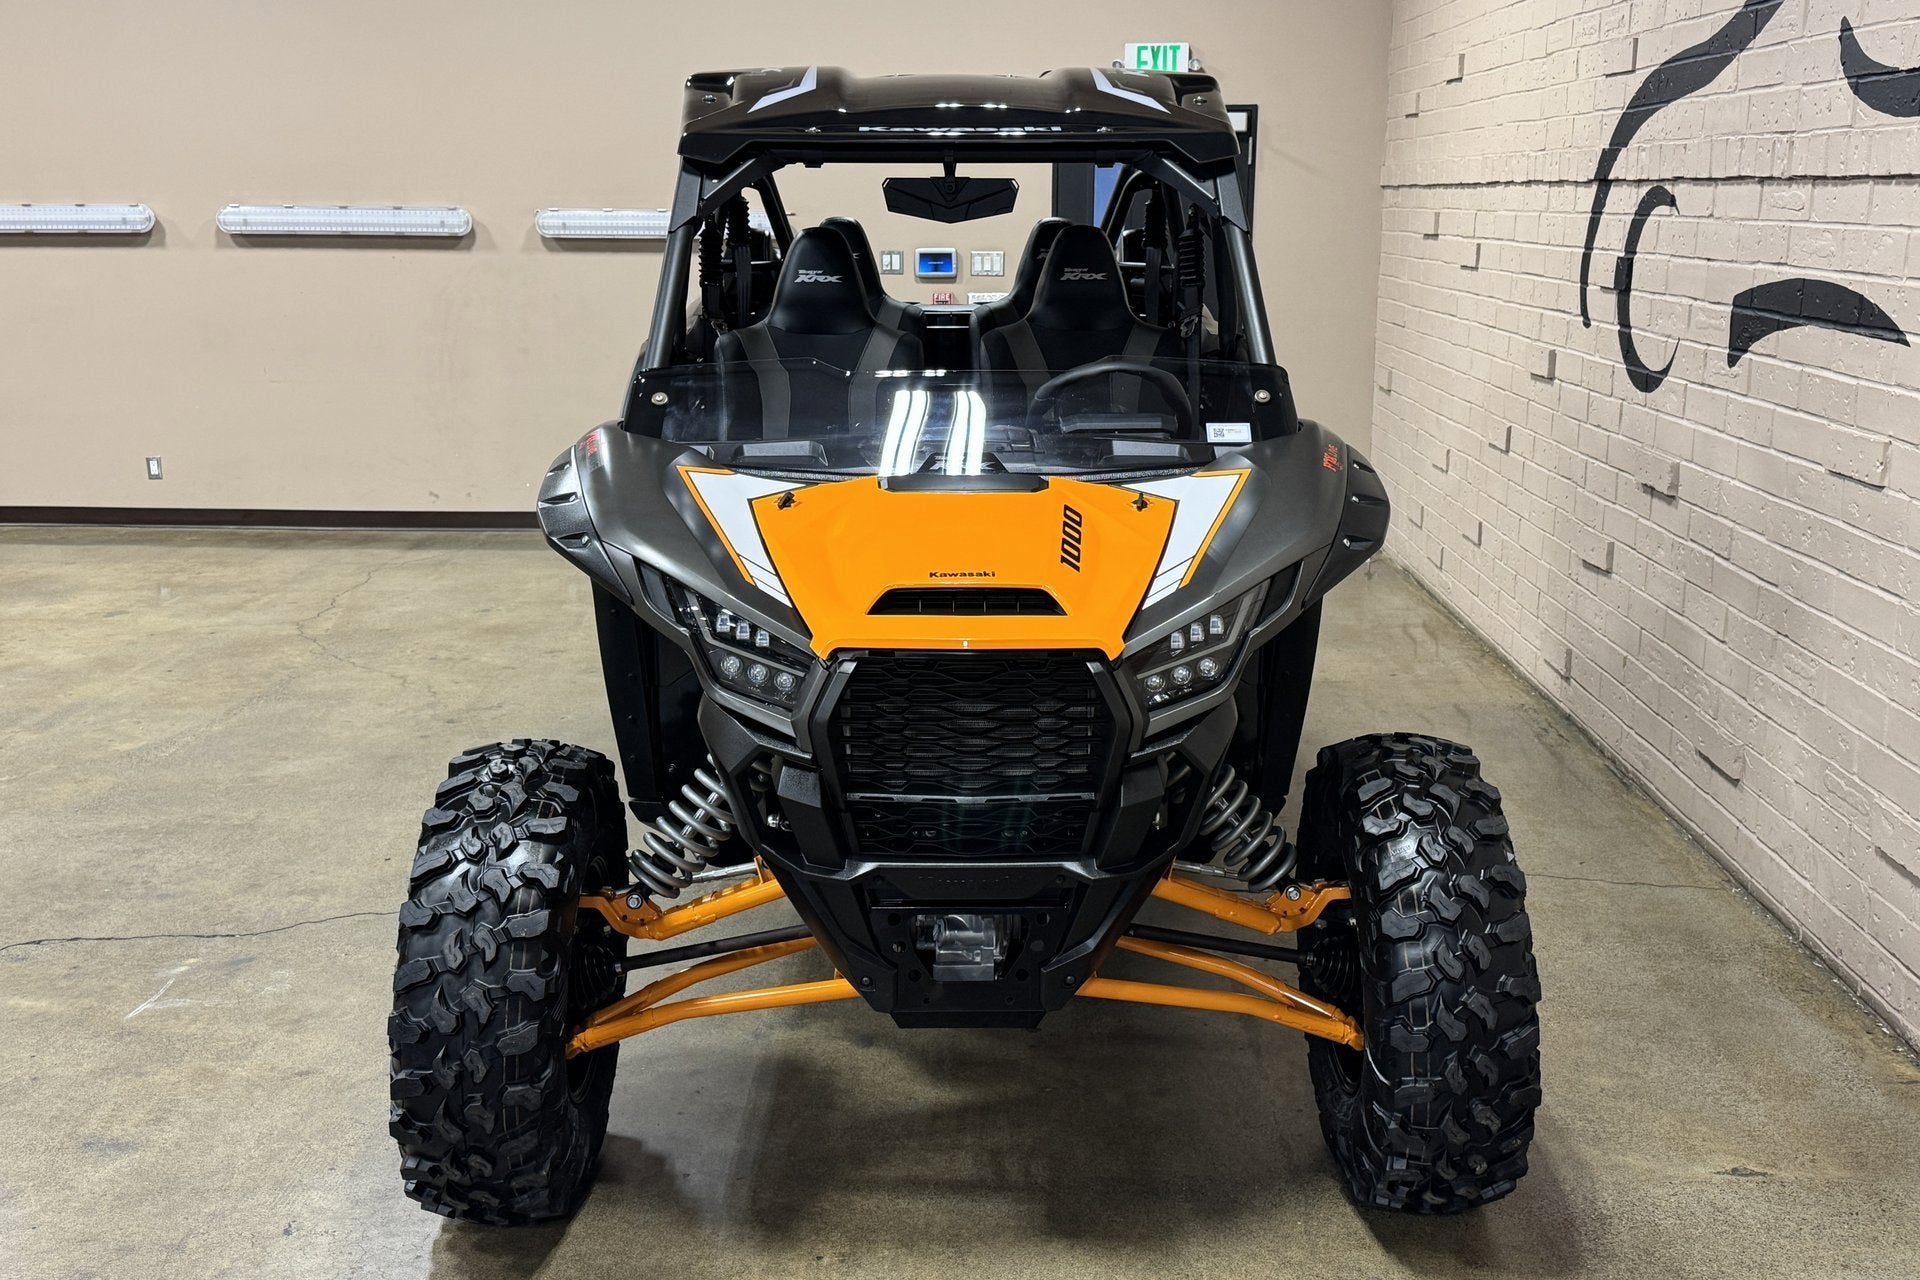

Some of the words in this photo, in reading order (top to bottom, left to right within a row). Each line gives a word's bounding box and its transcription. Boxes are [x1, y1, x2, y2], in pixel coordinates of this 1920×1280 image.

[1136, 45, 1181, 72] EXIT
[794, 274, 844, 283] KRX
[1059, 272, 1109, 281] KRX
[933, 293, 951, 301] FIRE
[1060, 503, 1083, 573] 1000
[928, 570, 996, 578] Kawasaki
